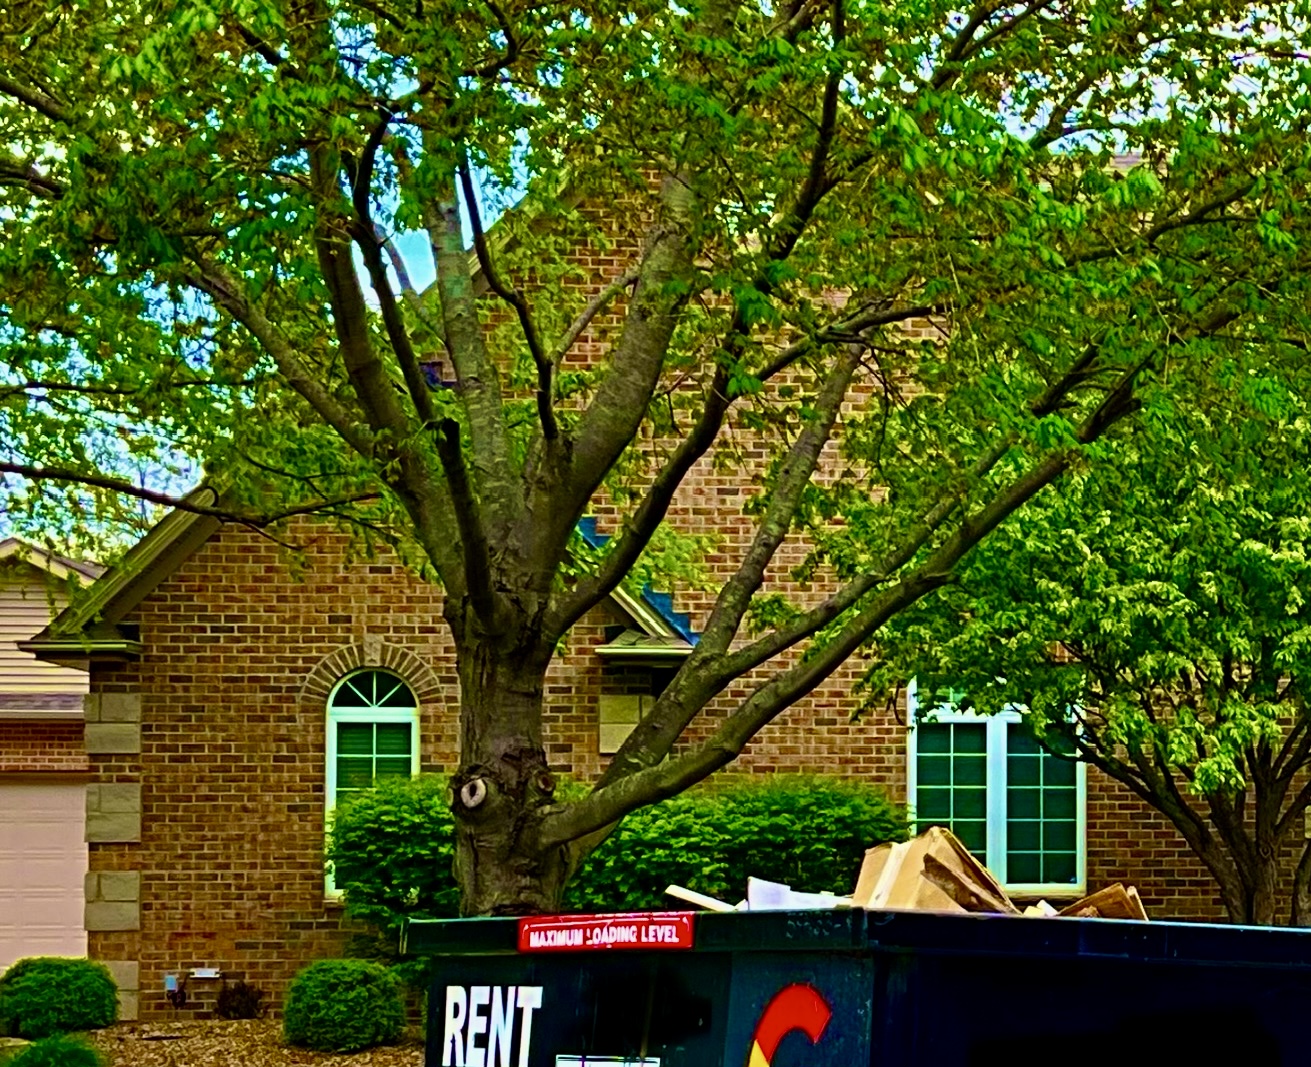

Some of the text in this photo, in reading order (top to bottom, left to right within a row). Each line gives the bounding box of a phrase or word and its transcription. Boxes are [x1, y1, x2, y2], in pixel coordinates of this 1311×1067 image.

[529, 925, 680, 948] MAXIMUM LOADING LEVEL
